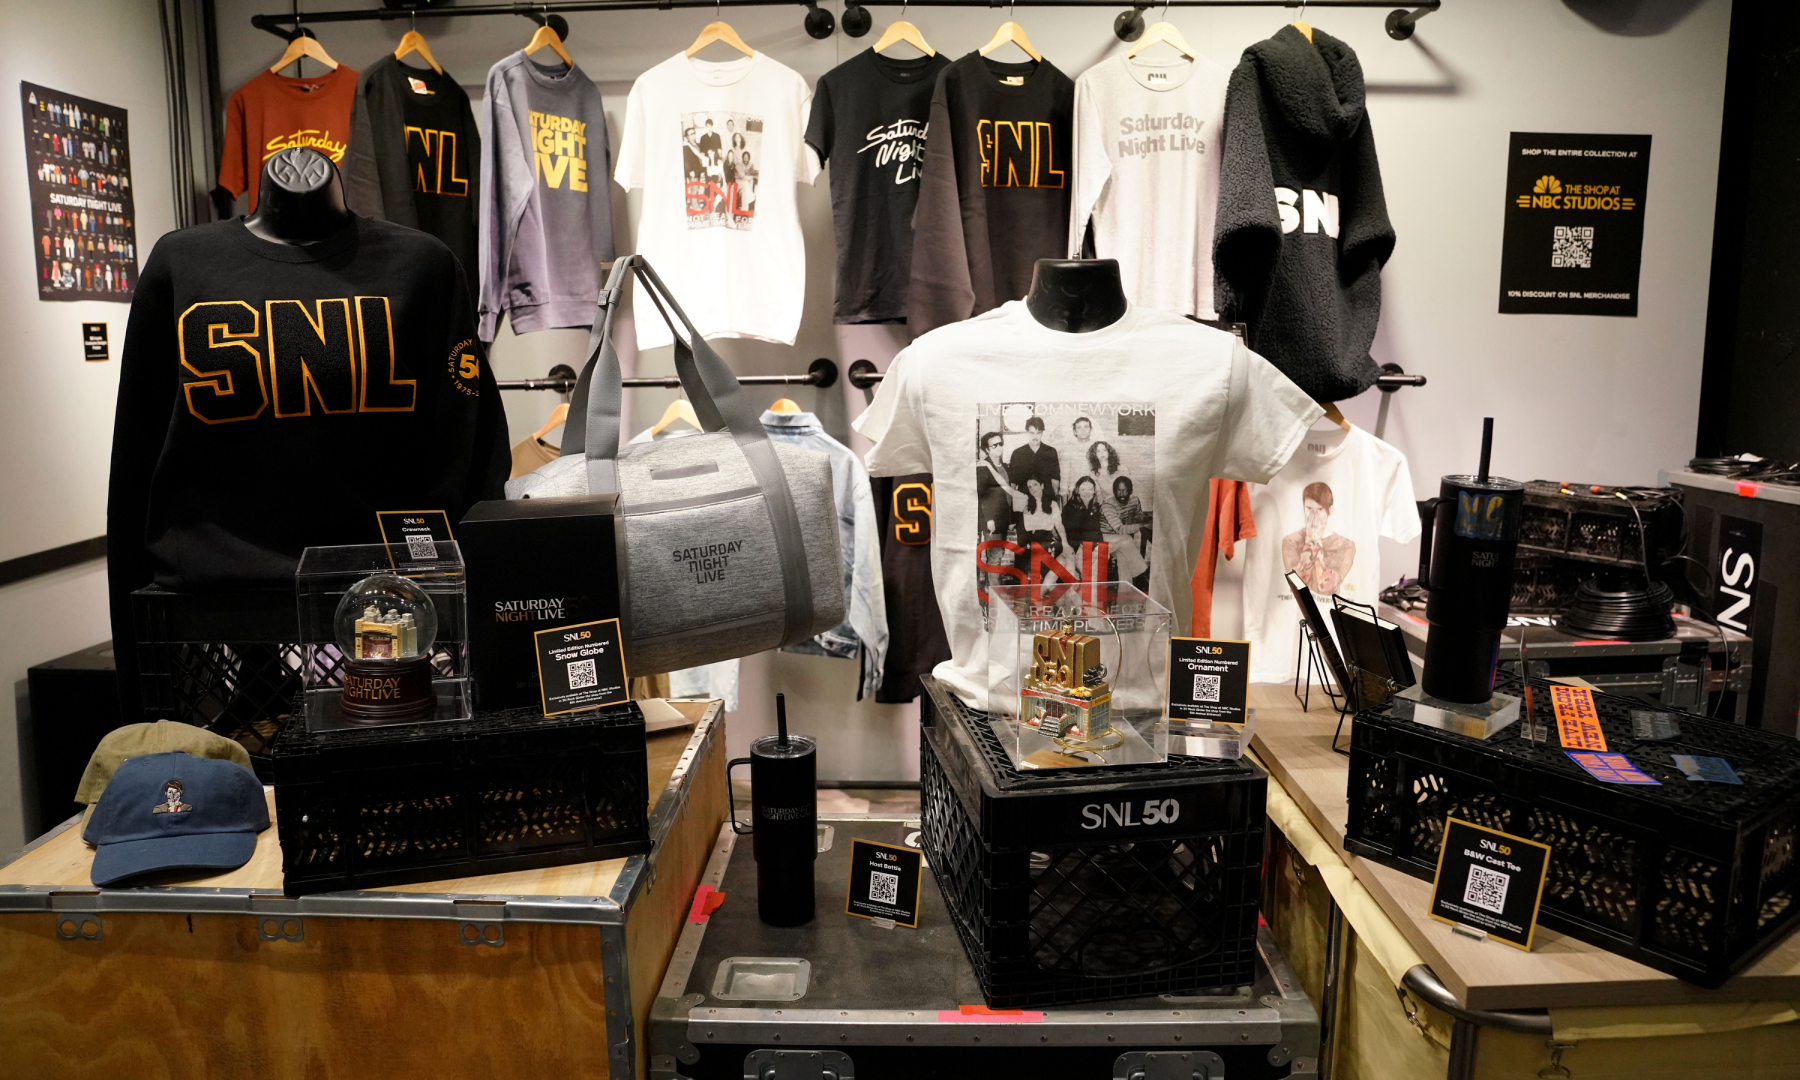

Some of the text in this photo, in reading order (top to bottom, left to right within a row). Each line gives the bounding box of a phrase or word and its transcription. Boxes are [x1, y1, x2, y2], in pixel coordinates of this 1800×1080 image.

[528, 109, 586, 136] ATURDAY
[1120, 112, 1204, 135] Saturday
[262, 129, 347, 163] Saturday
[531, 126, 586, 159] IGHT
[857, 119, 929, 153] Saturd
[1118, 134, 1205, 159] Night Live
[404, 124, 468, 197] NL
[875, 139, 926, 168] Night
[1522, 148, 1542, 156] SHOP
[1558, 149, 1583, 157] ENTIRE
[1584, 150, 1627, 158] COLLECTION
[534, 152, 588, 193] IVE
[895, 162, 923, 185] Liv
[685, 180, 754, 217] SNL
[1565, 184, 1621, 195] THE SHOP AT
[49, 192, 87, 207] SATURDAY
[107, 201, 123, 213] LIVE
[1274, 187, 1340, 239] SN
[1532, 195, 1621, 210] NBC STUDIOS
[1583, 292, 1630, 300] MERCHANDISE
[178, 296, 417, 425] SNL
[448, 339, 473, 373] SATURDAY
[459, 353, 479, 379] 5
[453, 379, 480, 397] 1975-2
[673, 540, 742, 562] SATURDAY
[1472, 551, 1499, 561] SATU
[689, 555, 729, 573] NIGHT
[976, 539, 1149, 605] SNL
[1471, 558, 1496, 568] NIGH
[696, 569, 726, 584] LIVE
[1716, 547, 1755, 637] SN
[494, 598, 565, 613] SATURDAY
[1506, 616, 1557, 627] SN
[548, 640, 609, 655] Limited Edition Numbered
[563, 630, 592, 643] SNL50
[555, 647, 604, 661] Snow Globe
[1195, 645, 1223, 655] SNL50
[1043, 661, 1072, 688] 50
[1187, 663, 1229, 673] Ornament
[1555, 687, 1583, 748] LIVE FROM
[1572, 689, 1602, 750] NEW YORK
[762, 805, 800, 815] SATURDAY
[800, 803, 812, 818] 50
[1080, 798, 1180, 830] SNL50
[875, 851, 898, 862] SNL50
[1479, 838, 1511, 856] SNL50
[869, 860, 902, 872] Host Bottle
[1463, 848, 1521, 872] B&W Cast Tee
